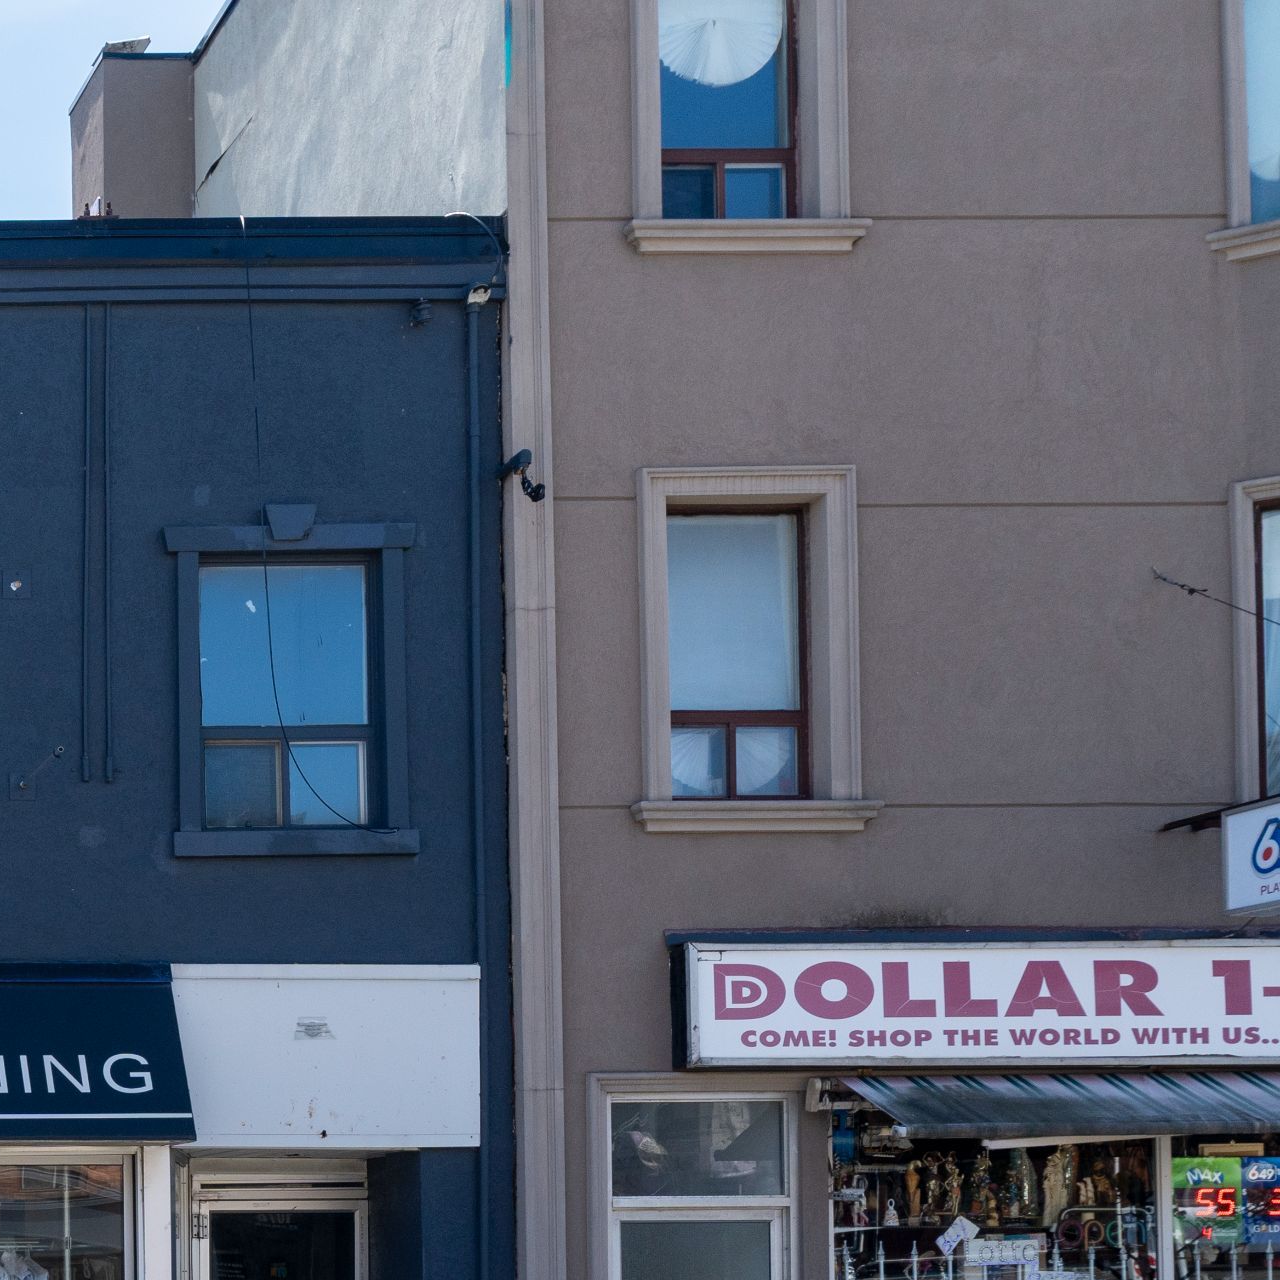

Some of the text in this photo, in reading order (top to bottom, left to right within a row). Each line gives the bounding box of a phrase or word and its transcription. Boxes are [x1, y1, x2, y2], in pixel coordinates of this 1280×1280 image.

[1260, 883, 1280, 896] PLA
[713, 960, 1164, 1020] DOLLAR
[741, 1029, 837, 1048] COME!
[848, 1029, 932, 1048] SHOP
[943, 1028, 998, 1047] THE
[1008, 1028, 1121, 1046] WORLD
[1132, 1027, 1210, 1045] WITH
[1186, 1168, 1223, 1185] MAX
[1248, 1165, 1275, 1181] 649
[1195, 1188, 1236, 1217] 55
